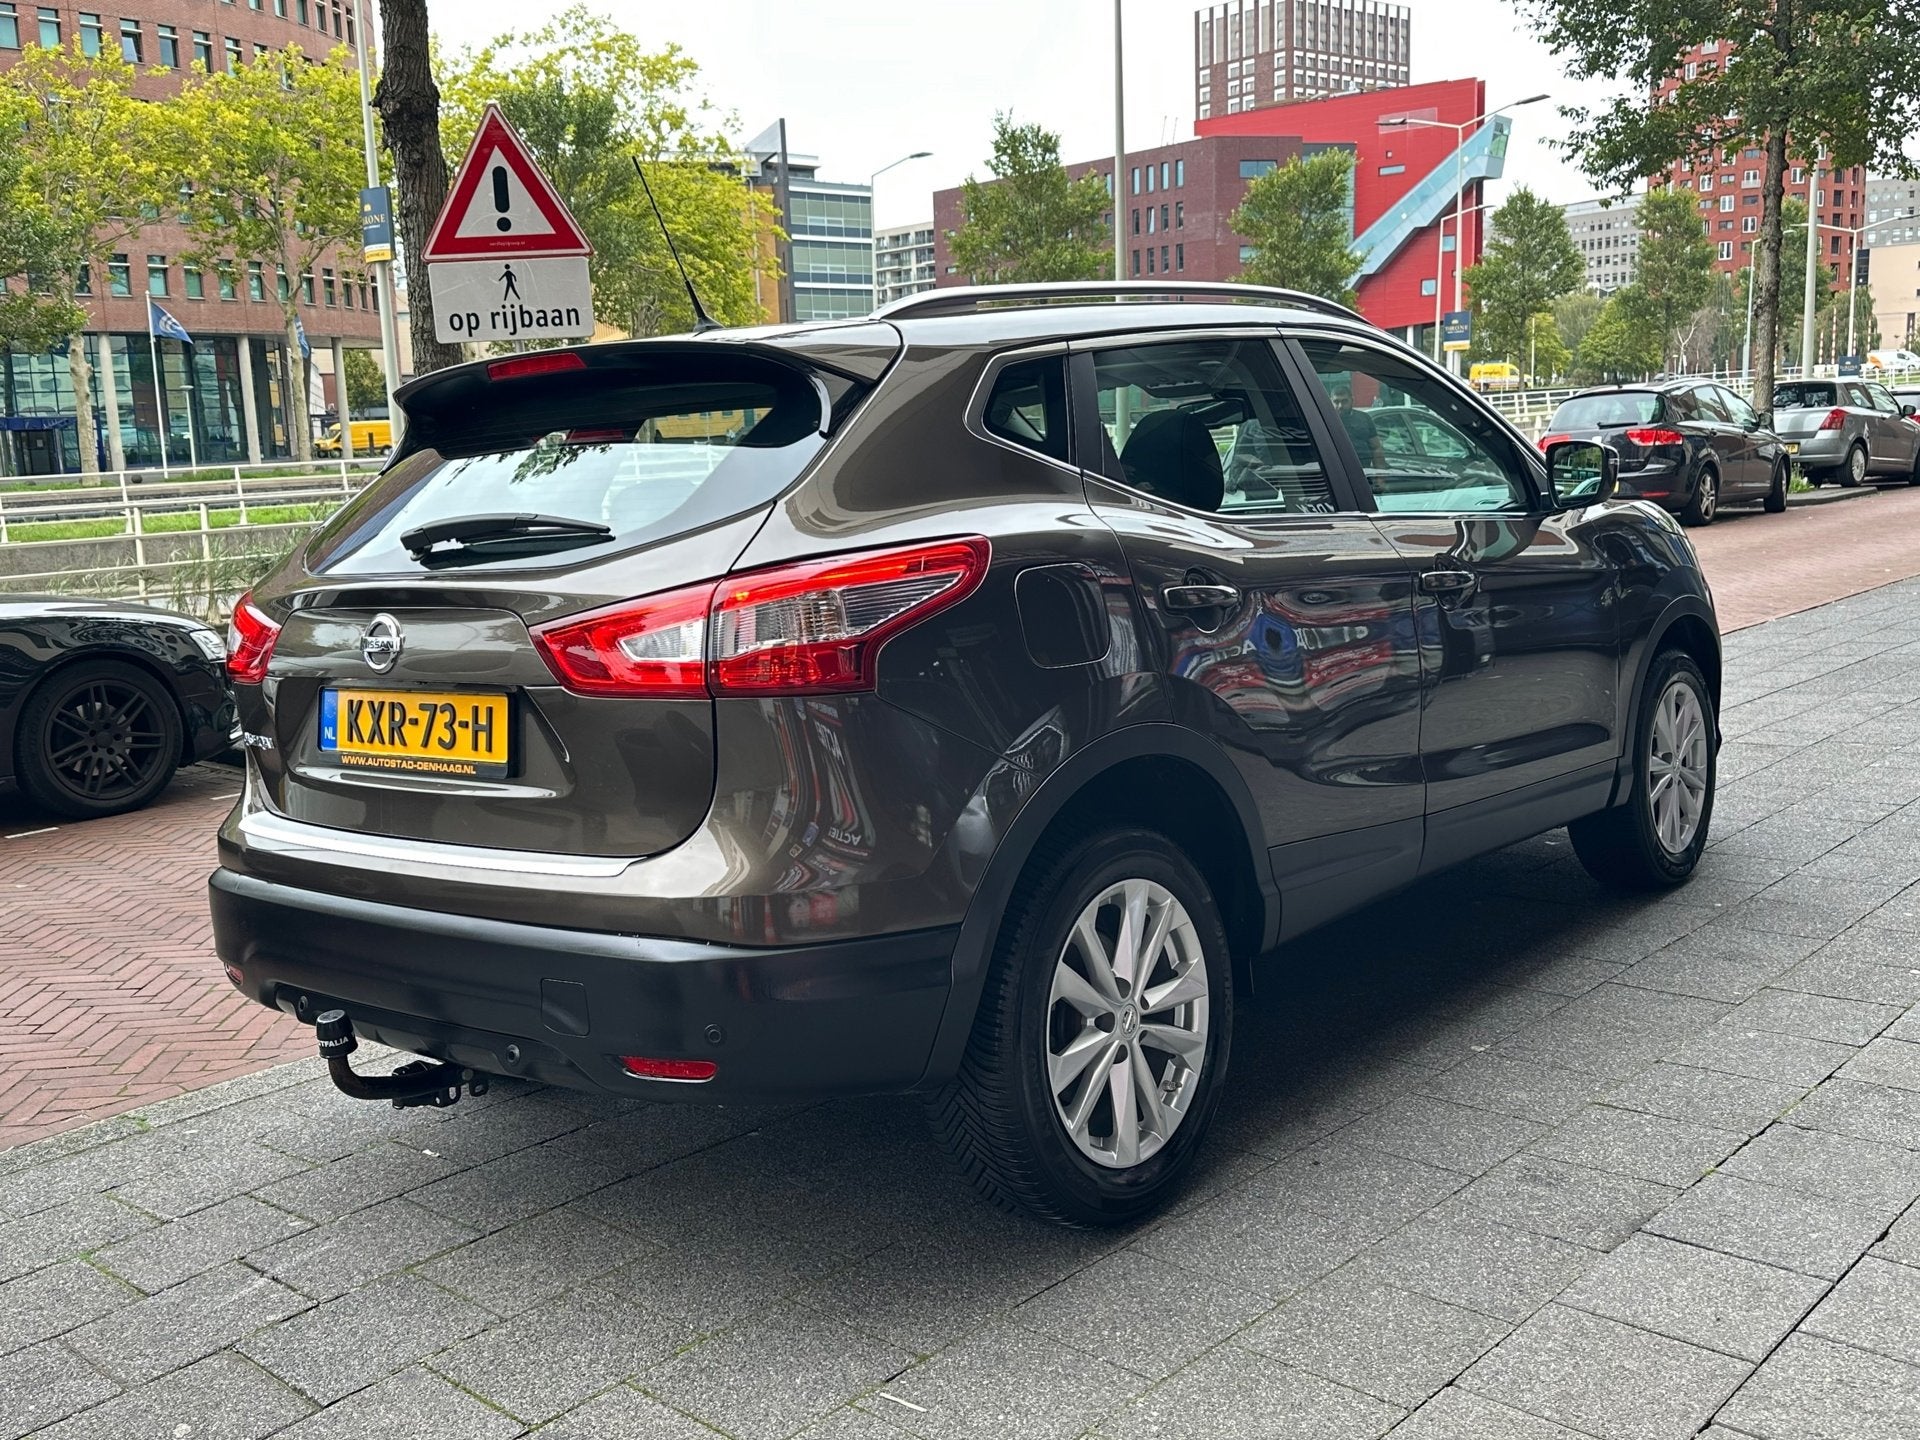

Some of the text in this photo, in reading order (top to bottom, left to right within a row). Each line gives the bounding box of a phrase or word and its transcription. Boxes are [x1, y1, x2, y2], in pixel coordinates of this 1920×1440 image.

[449, 304, 580, 337] op rijbaan
[362, 639, 394, 649] NISSAN
[324, 727, 336, 740] NL
[347, 699, 493, 753] KXR-73-H
[341, 756, 476, 774] WWW.AUTOSTAD-DENHAAG.NL
